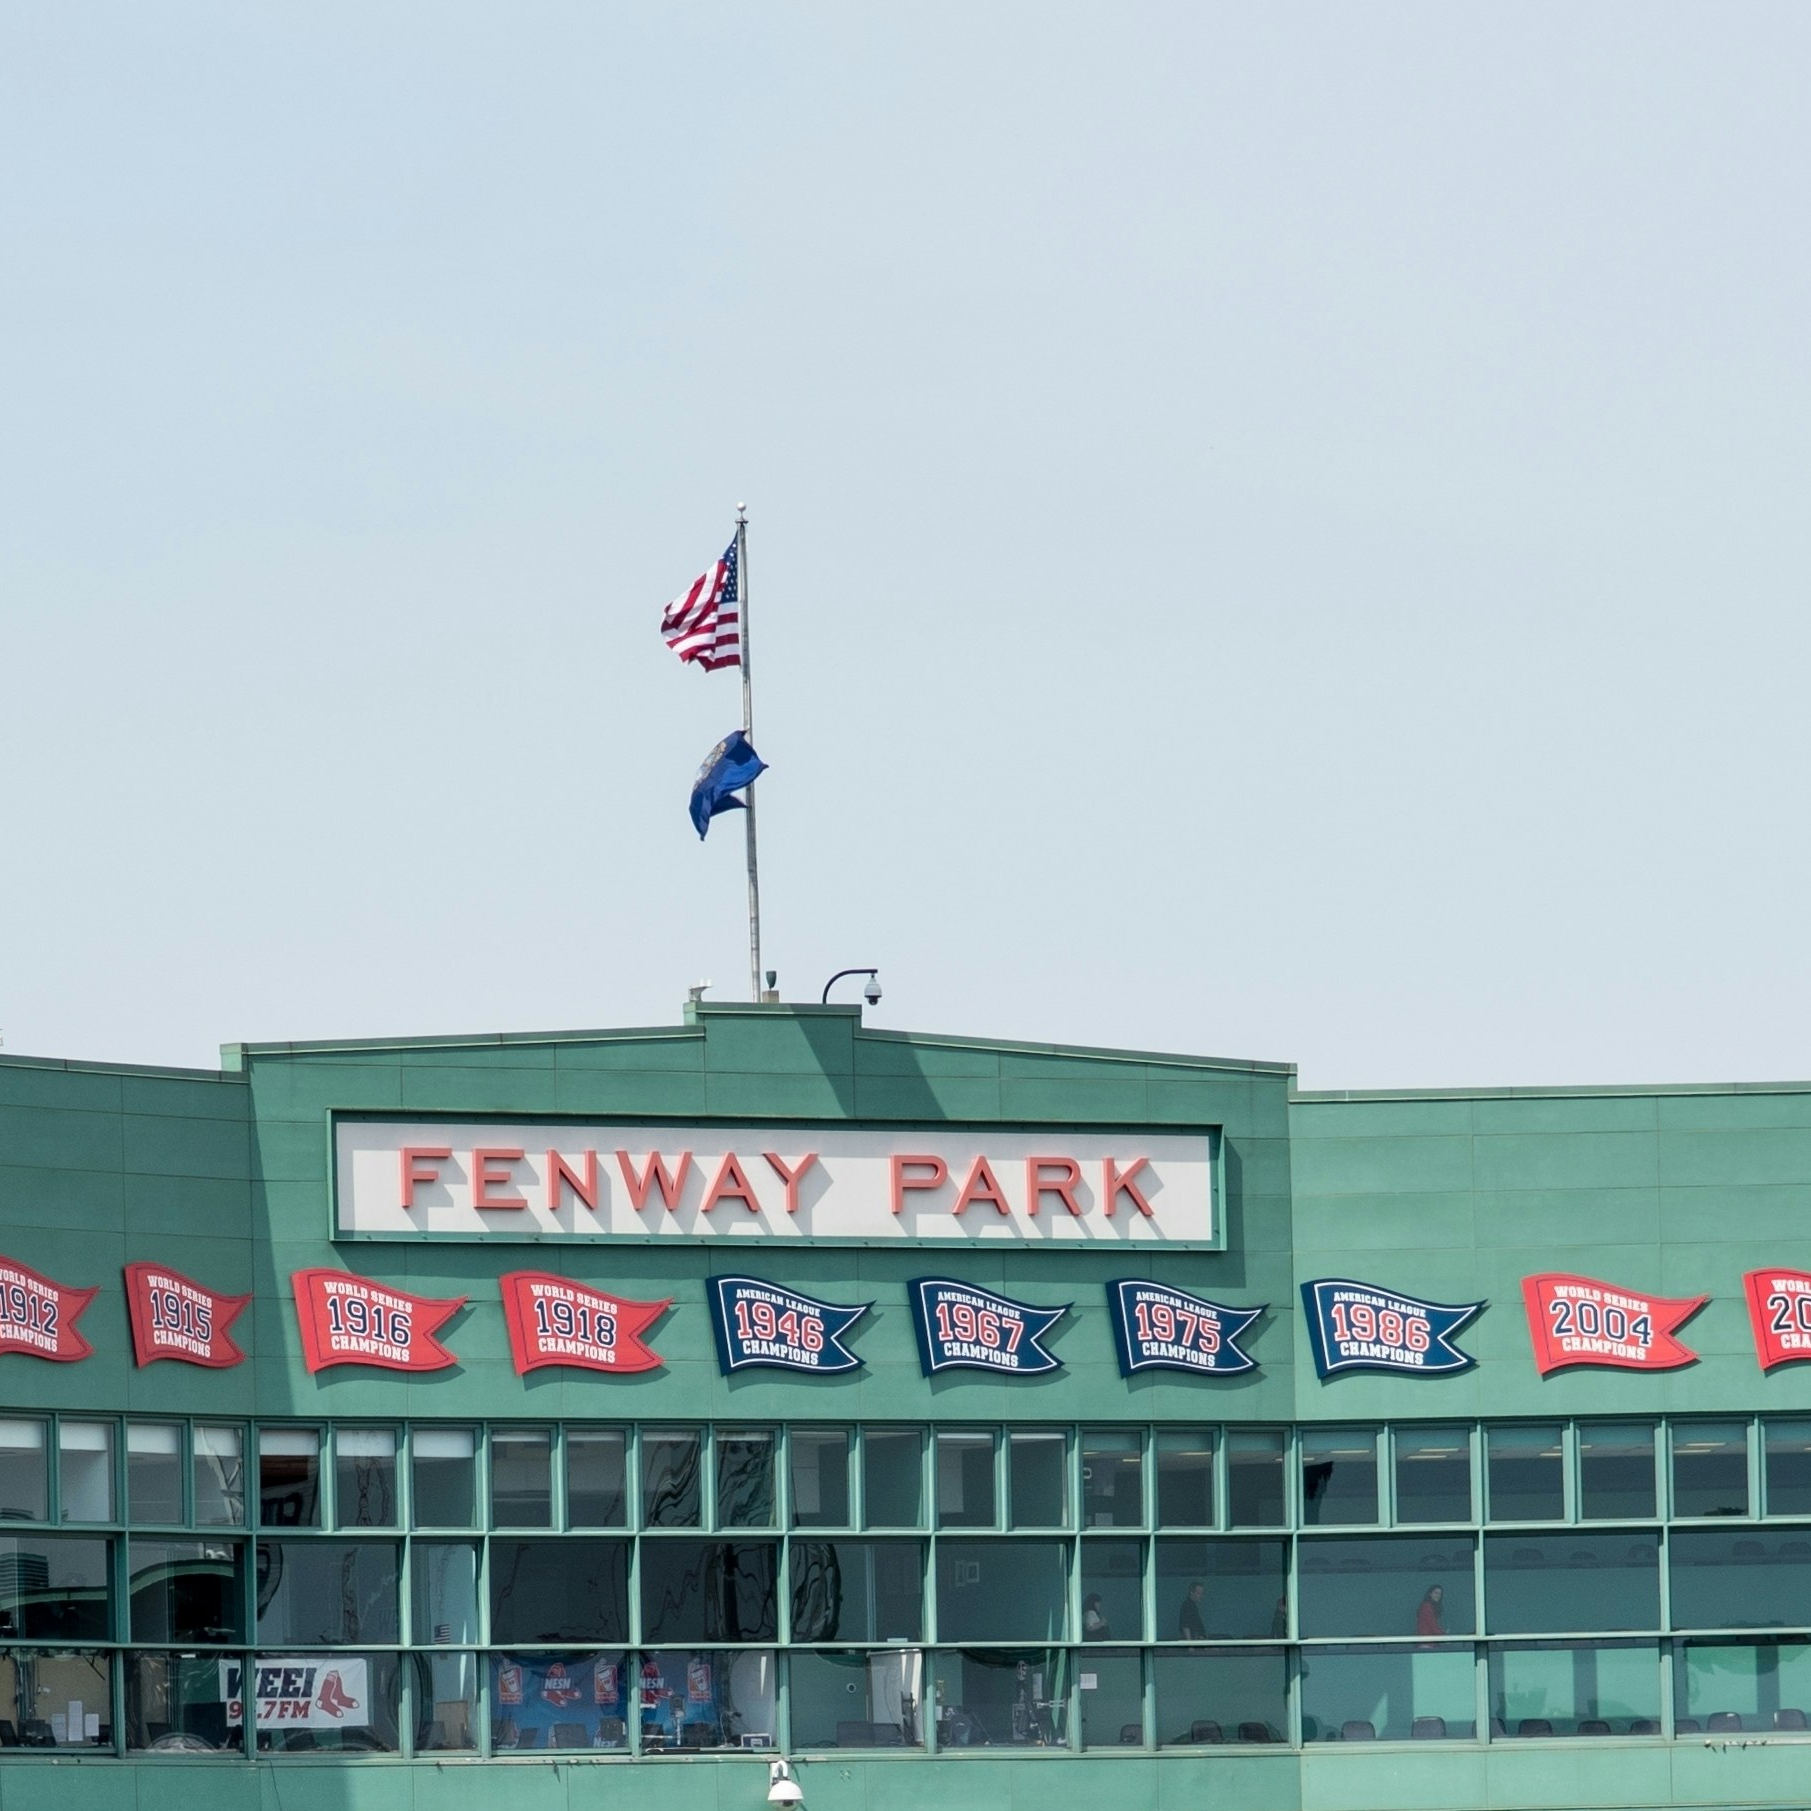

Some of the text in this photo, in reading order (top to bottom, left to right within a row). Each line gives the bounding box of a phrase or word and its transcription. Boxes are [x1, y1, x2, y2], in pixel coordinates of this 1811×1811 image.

[399, 1146, 1155, 1218] FENWAY PARK
[28, 1279, 59, 1301] SERIES
[148, 1275, 212, 1309] WORLD SERIES
[324, 1281, 413, 1313] WORLD SERIES
[531, 1284, 618, 1315] WORLD SERIES
[736, 1289, 821, 1317] AMERICAN LEAGUE
[1554, 1285, 1648, 1313] WORLD SERIES
[151, 1289, 212, 1343] 1915
[938, 1291, 1021, 1319] AMERICAN LEAGUE
[1137, 1291, 1217, 1320] AMERICAN LEAGUE
[1334, 1292, 1426, 1318] AMERICAN LEAGUE
[327, 1296, 411, 1347] 1916
[534, 1298, 617, 1348] 1918
[735, 1301, 824, 1351] 1946
[937, 1302, 1024, 1353] 1967
[1135, 1302, 1221, 1353] 1975
[1331, 1303, 1430, 1351] 1986
[1549, 1300, 1652, 1347] 2004
[0, 1324, 58, 1352] CHAMPIONS
[154, 1330, 210, 1358] CHAMPIONS
[331, 1335, 410, 1361] CHAMPIONS
[539, 1339, 615, 1363] CHAMPIONS
[1562, 1337, 1646, 1360] CHAMPIONS
[742, 1340, 818, 1365] CHAMPIONS
[943, 1342, 1019, 1367] CHAMPIONS
[1143, 1342, 1215, 1367] CHAMPIONS
[1340, 1341, 1424, 1366] CHAMPIONS
[544, 1677, 572, 1689] NESN
